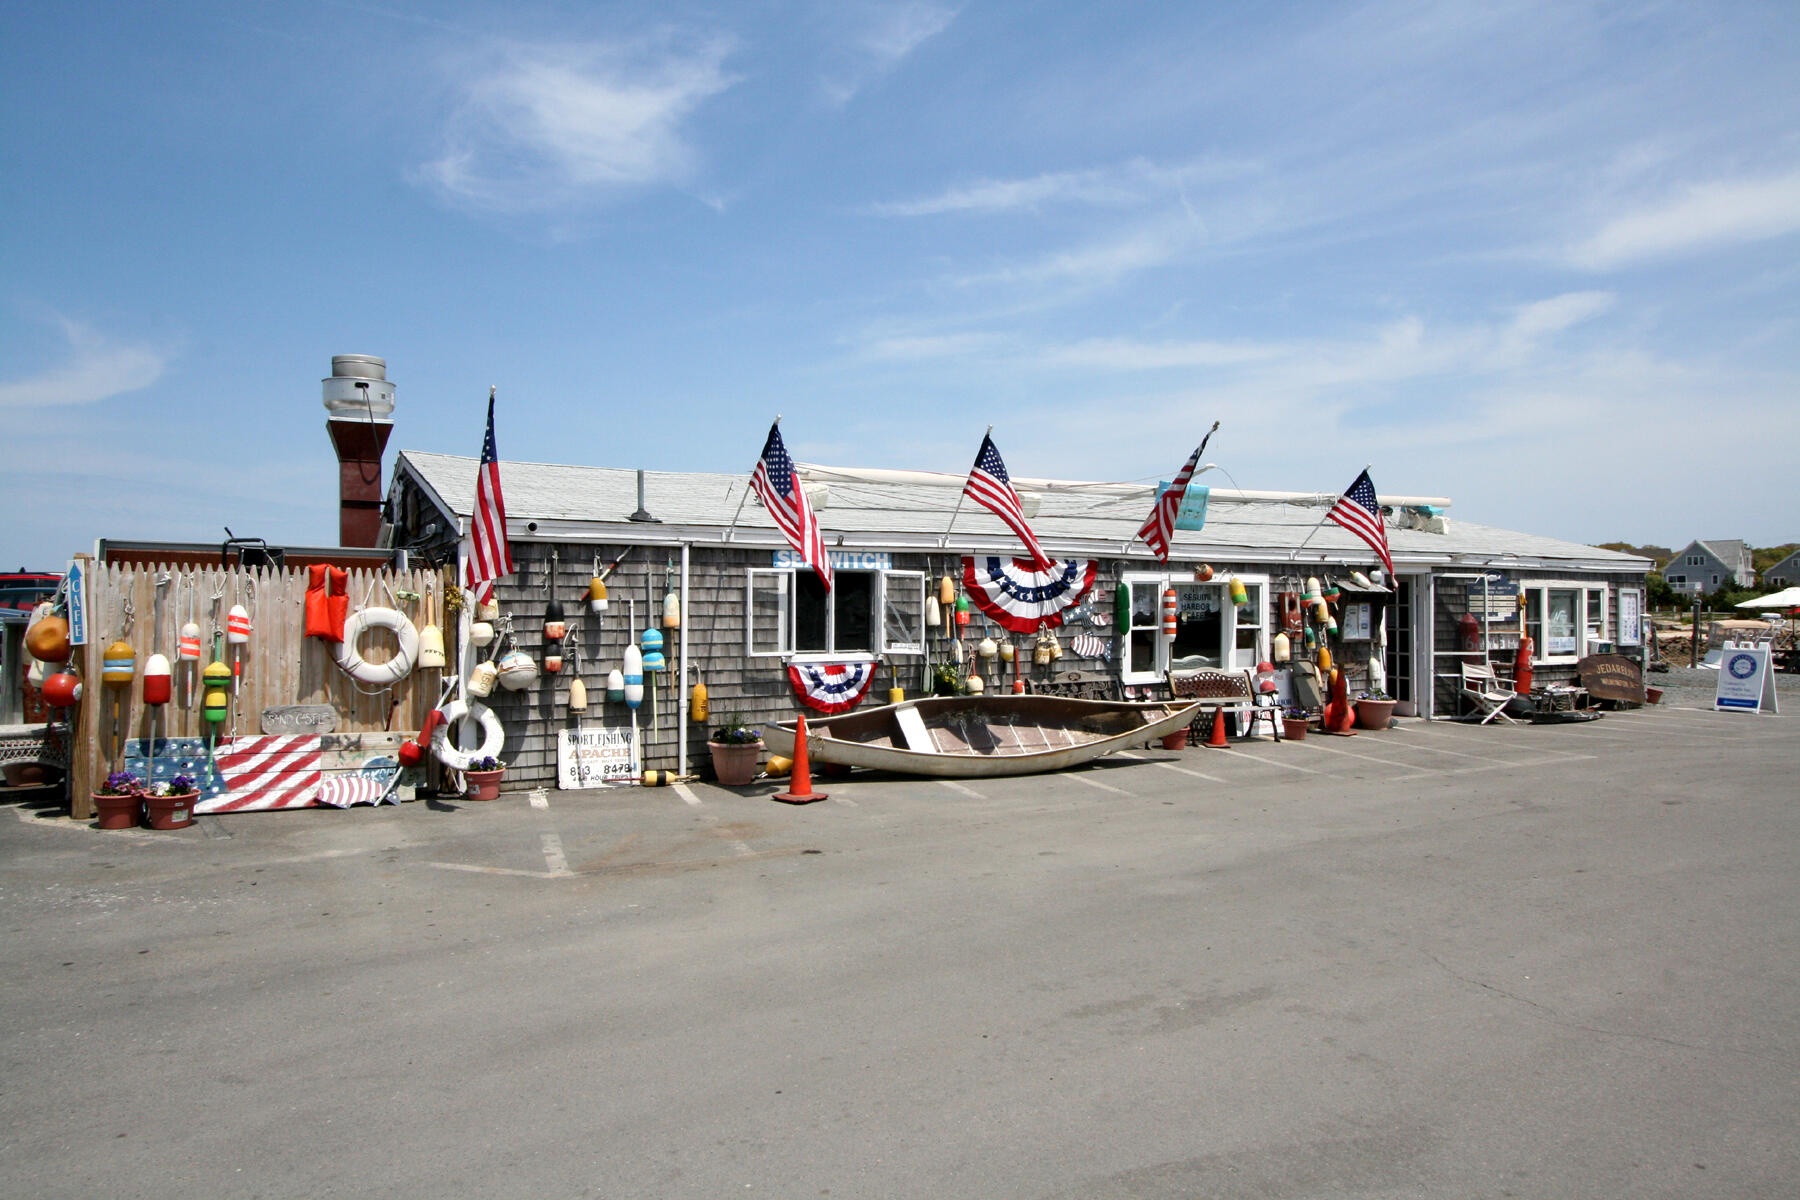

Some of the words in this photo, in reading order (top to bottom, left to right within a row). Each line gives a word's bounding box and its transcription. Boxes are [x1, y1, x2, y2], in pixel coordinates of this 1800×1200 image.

[777, 550, 814, 568] SE
[830, 552, 888, 568] WITCH
[71, 579, 82, 637] CAFE
[1181, 602, 1210, 610] HARBOR
[266, 713, 294, 726] SAND
[295, 712, 330, 726] CASTLE
[568, 734, 593, 746] SPORT
[598, 733, 631, 746] FISHING
[569, 748, 631, 759] APACHE
[570, 766, 591, 777] 83
